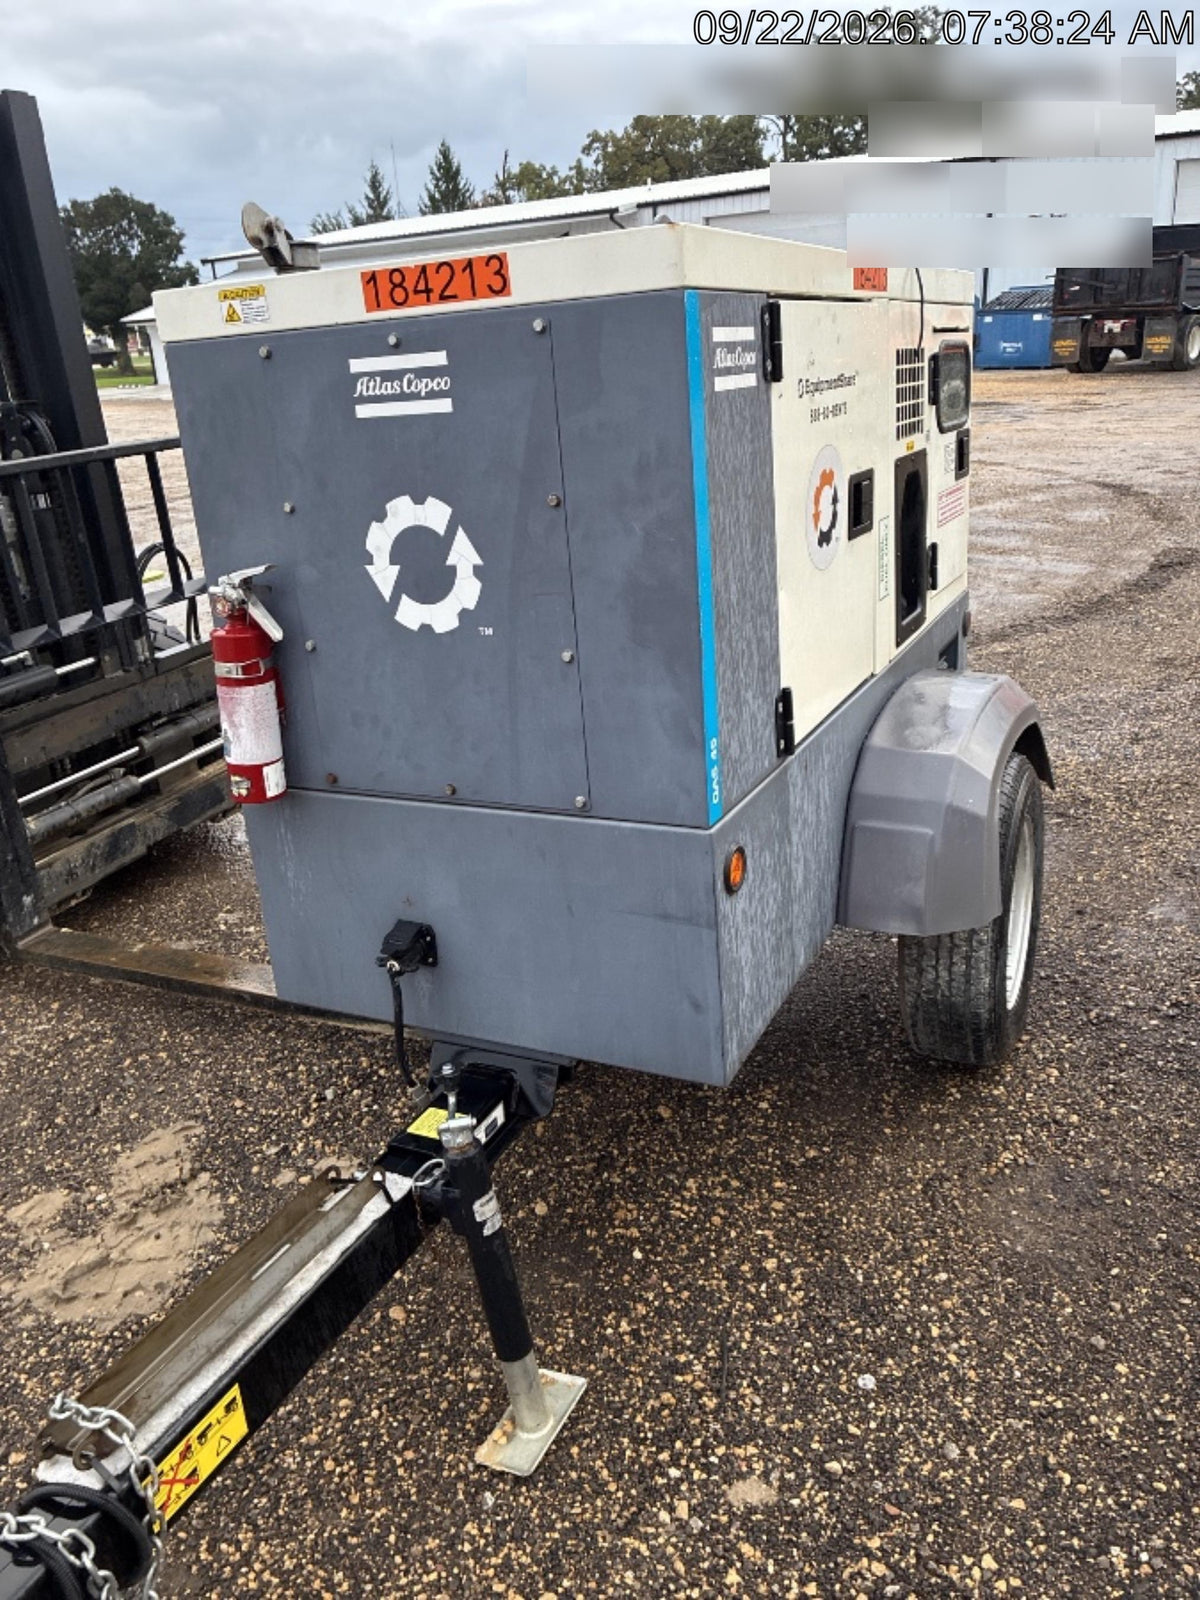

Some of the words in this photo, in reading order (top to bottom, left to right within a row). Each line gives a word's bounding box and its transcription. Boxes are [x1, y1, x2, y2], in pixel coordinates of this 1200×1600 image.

[366, 254, 508, 308] 184213
[353, 376, 401, 398] Atlas
[402, 372, 450, 397] Copco
